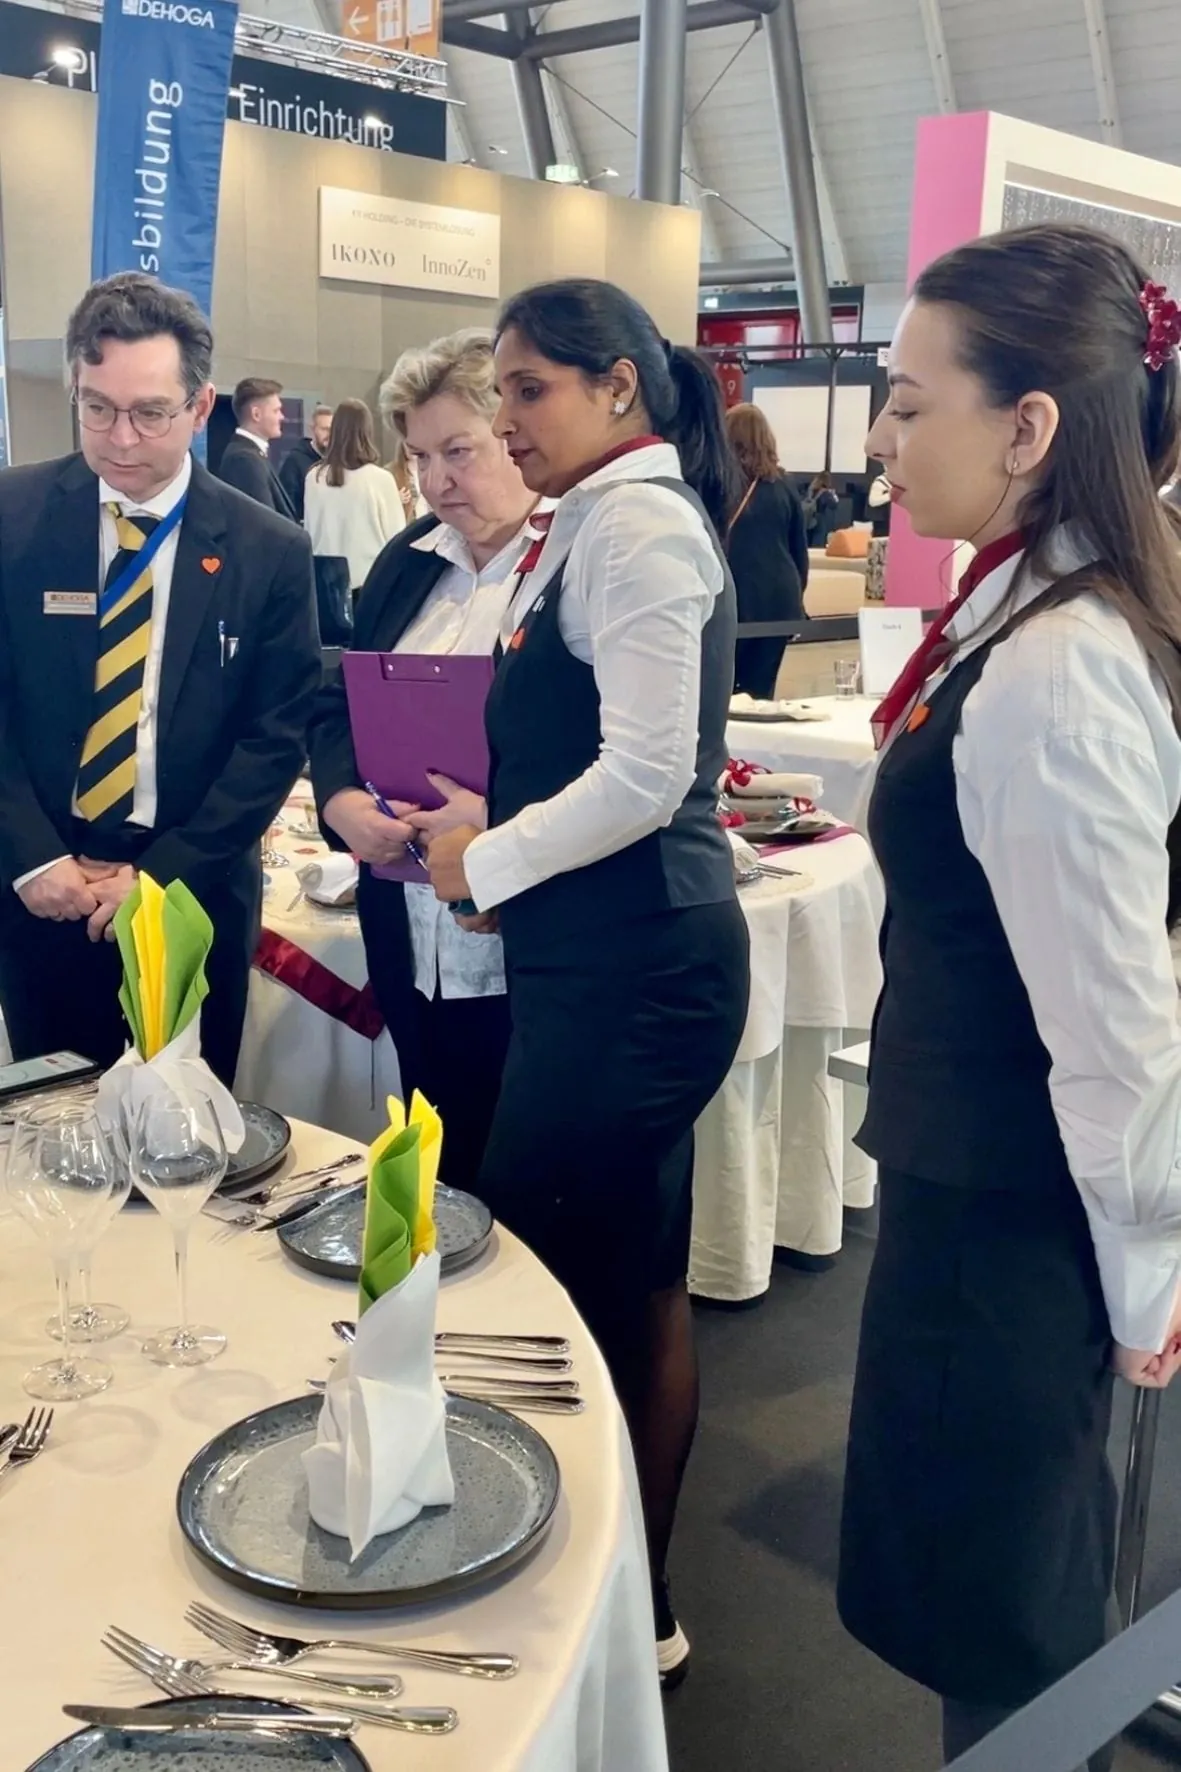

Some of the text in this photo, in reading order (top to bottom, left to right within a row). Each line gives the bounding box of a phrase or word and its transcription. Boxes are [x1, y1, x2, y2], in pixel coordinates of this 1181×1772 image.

[138, 0, 215, 29] DEHOGA
[238, 83, 395, 152] Einrichtung
[131, 78, 184, 273] sbildung
